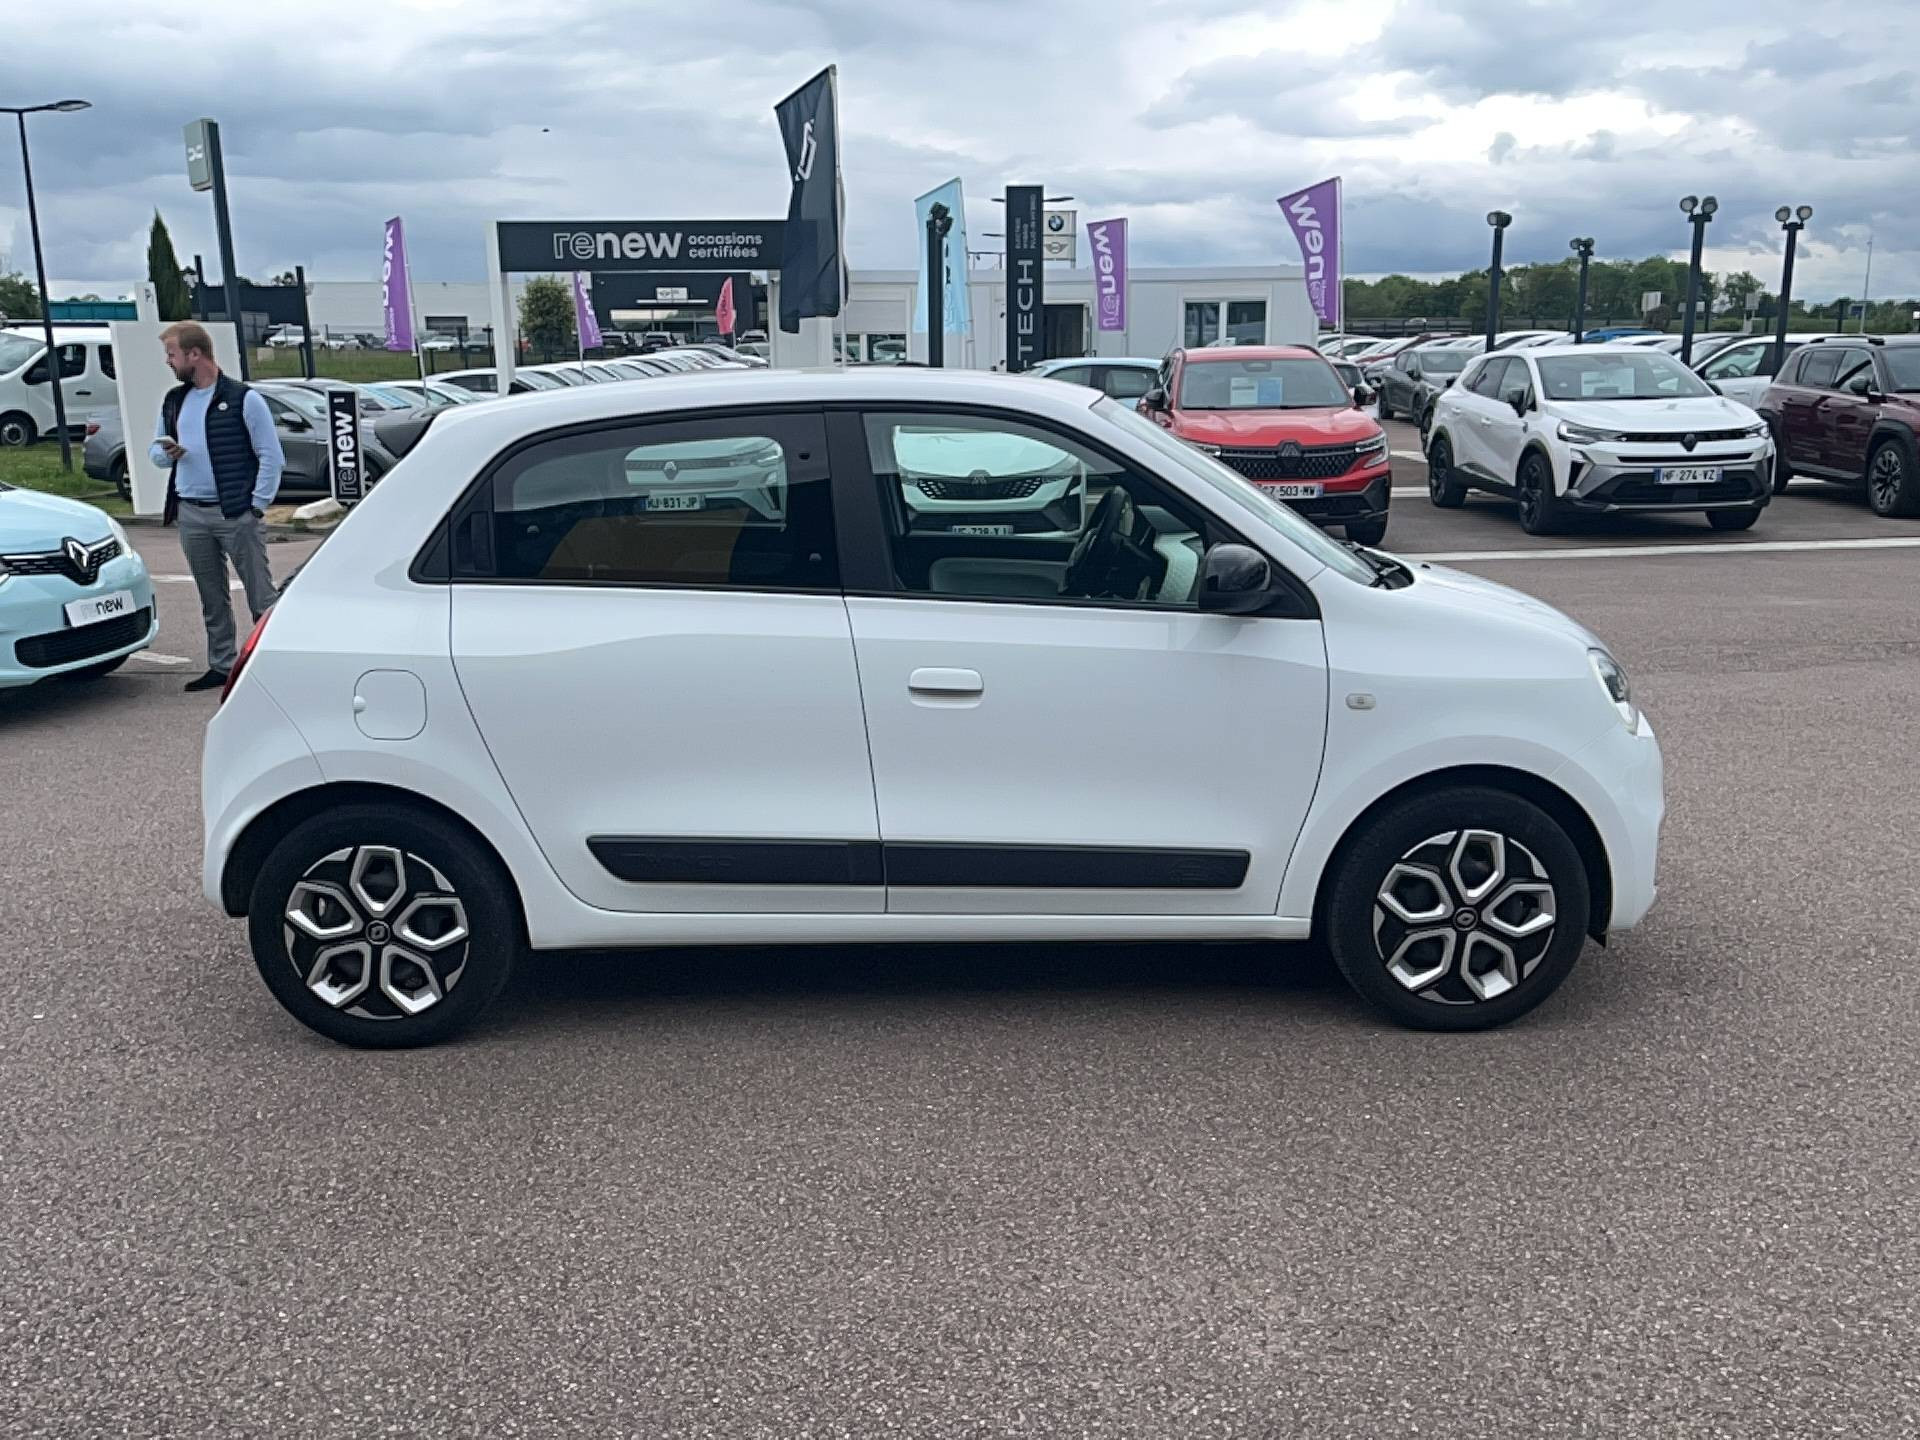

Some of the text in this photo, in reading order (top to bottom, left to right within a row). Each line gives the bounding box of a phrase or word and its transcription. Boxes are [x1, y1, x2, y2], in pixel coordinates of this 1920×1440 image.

[553, 231, 683, 259] renew
[688, 232, 763, 245] occasions
[688, 246, 760, 258] certifiées
[334, 410, 358, 495] renew
